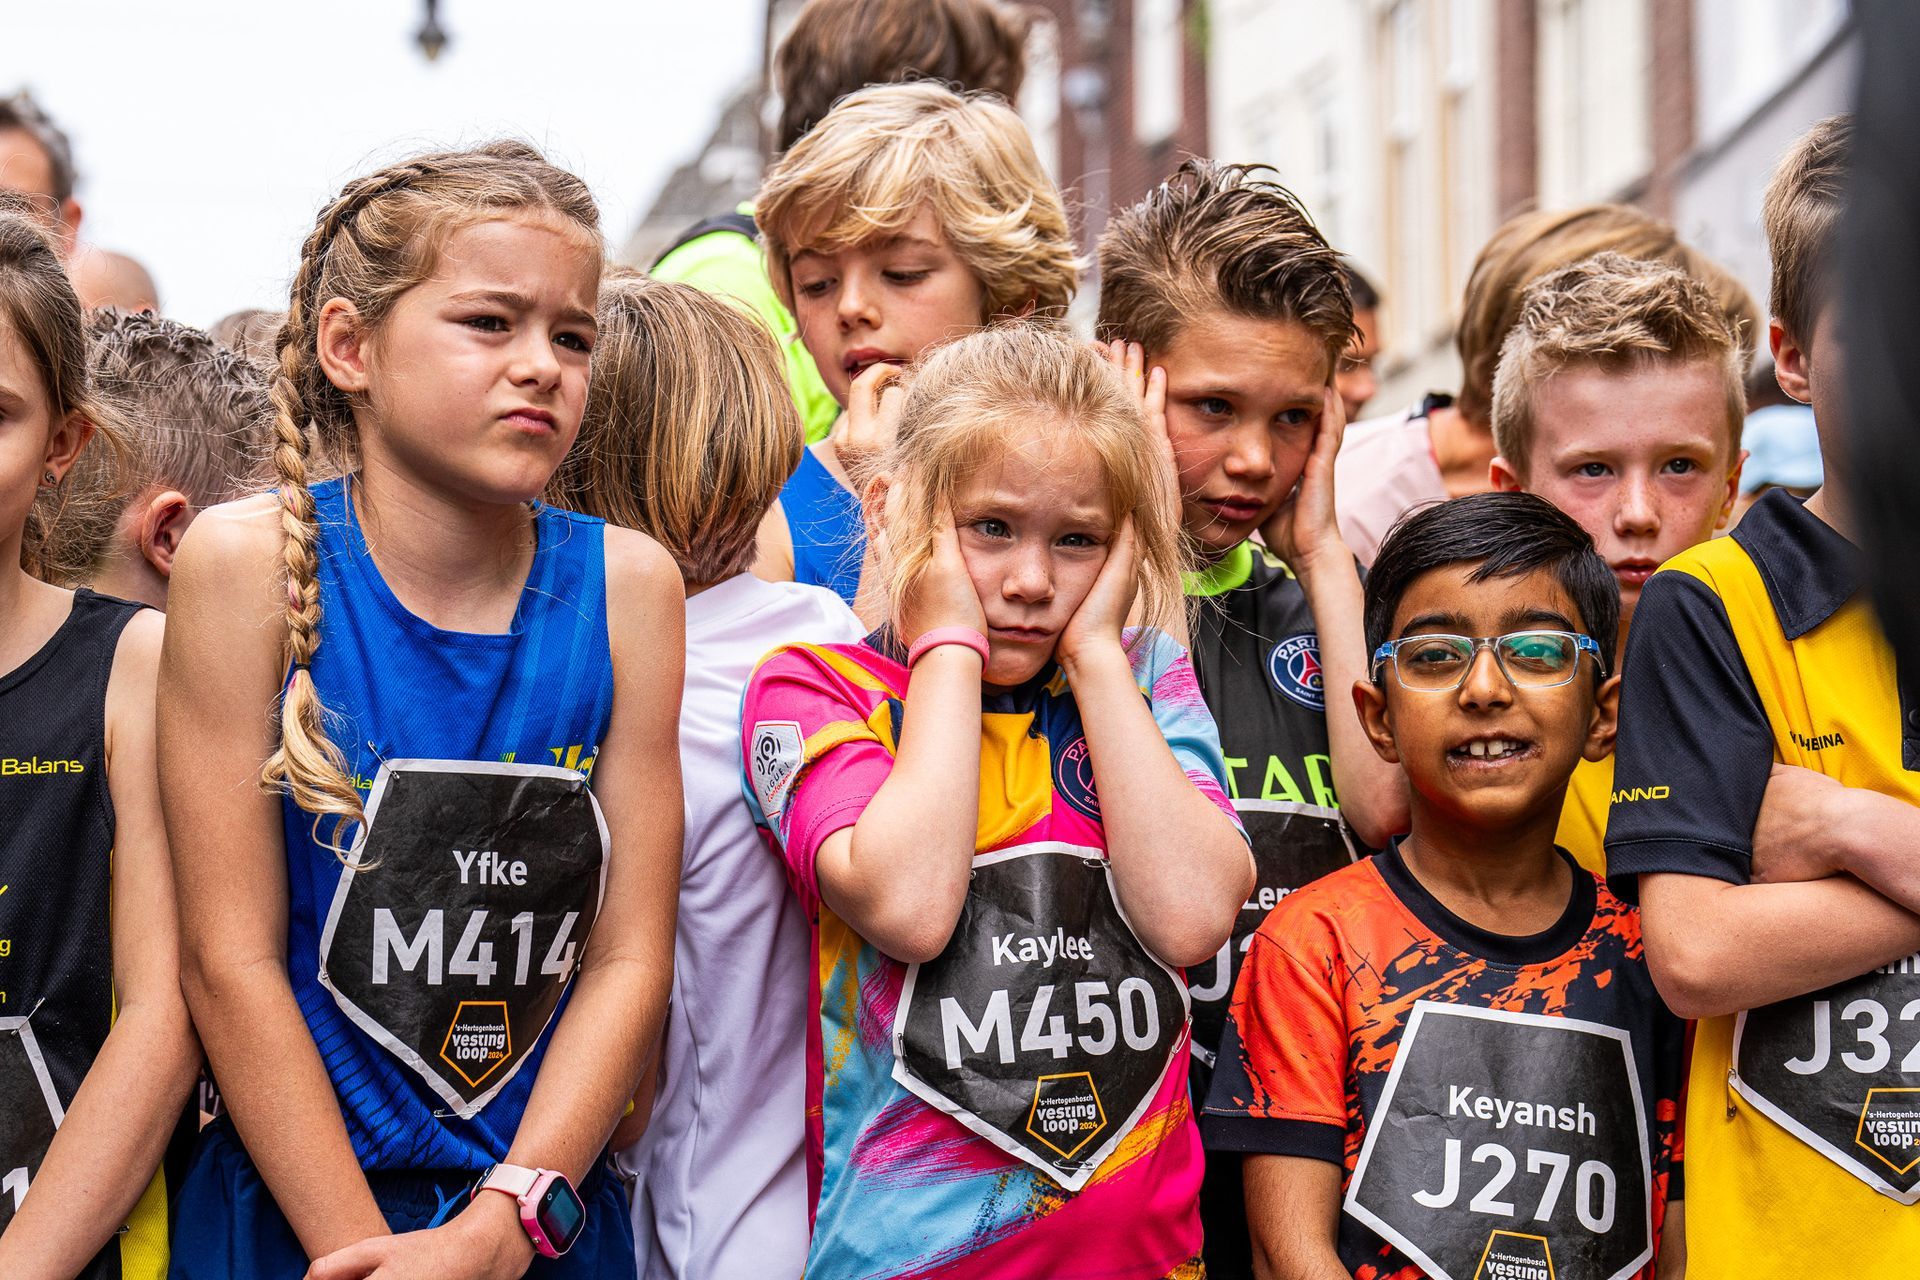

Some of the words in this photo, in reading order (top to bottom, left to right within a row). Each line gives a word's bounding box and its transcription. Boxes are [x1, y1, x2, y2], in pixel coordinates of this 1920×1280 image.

[1277, 638, 1320, 660] PARI
[1067, 741, 1089, 761] PA
[1, 756, 84, 776] Balans
[765, 768, 784, 796] LIGUE
[1611, 786, 1670, 804] ANNO
[452, 850, 528, 886] Yfke
[371, 907, 580, 986] M414
[991, 926, 1095, 968] Kaylee
[939, 976, 1161, 1071] M450
[452, 1033, 506, 1050] vesting
[456, 1046, 489, 1063] loop
[487, 1051, 504, 1059] 2024
[1036, 1103, 1096, 1121] vesting
[1449, 1084, 1596, 1136] Keyansh
[1042, 1118, 1079, 1135] loop
[1079, 1121, 1098, 1130] 2024
[1873, 1132, 1913, 1150] loop
[1411, 1138, 1617, 1235] J270
[1486, 1261, 1548, 1280] vesting
